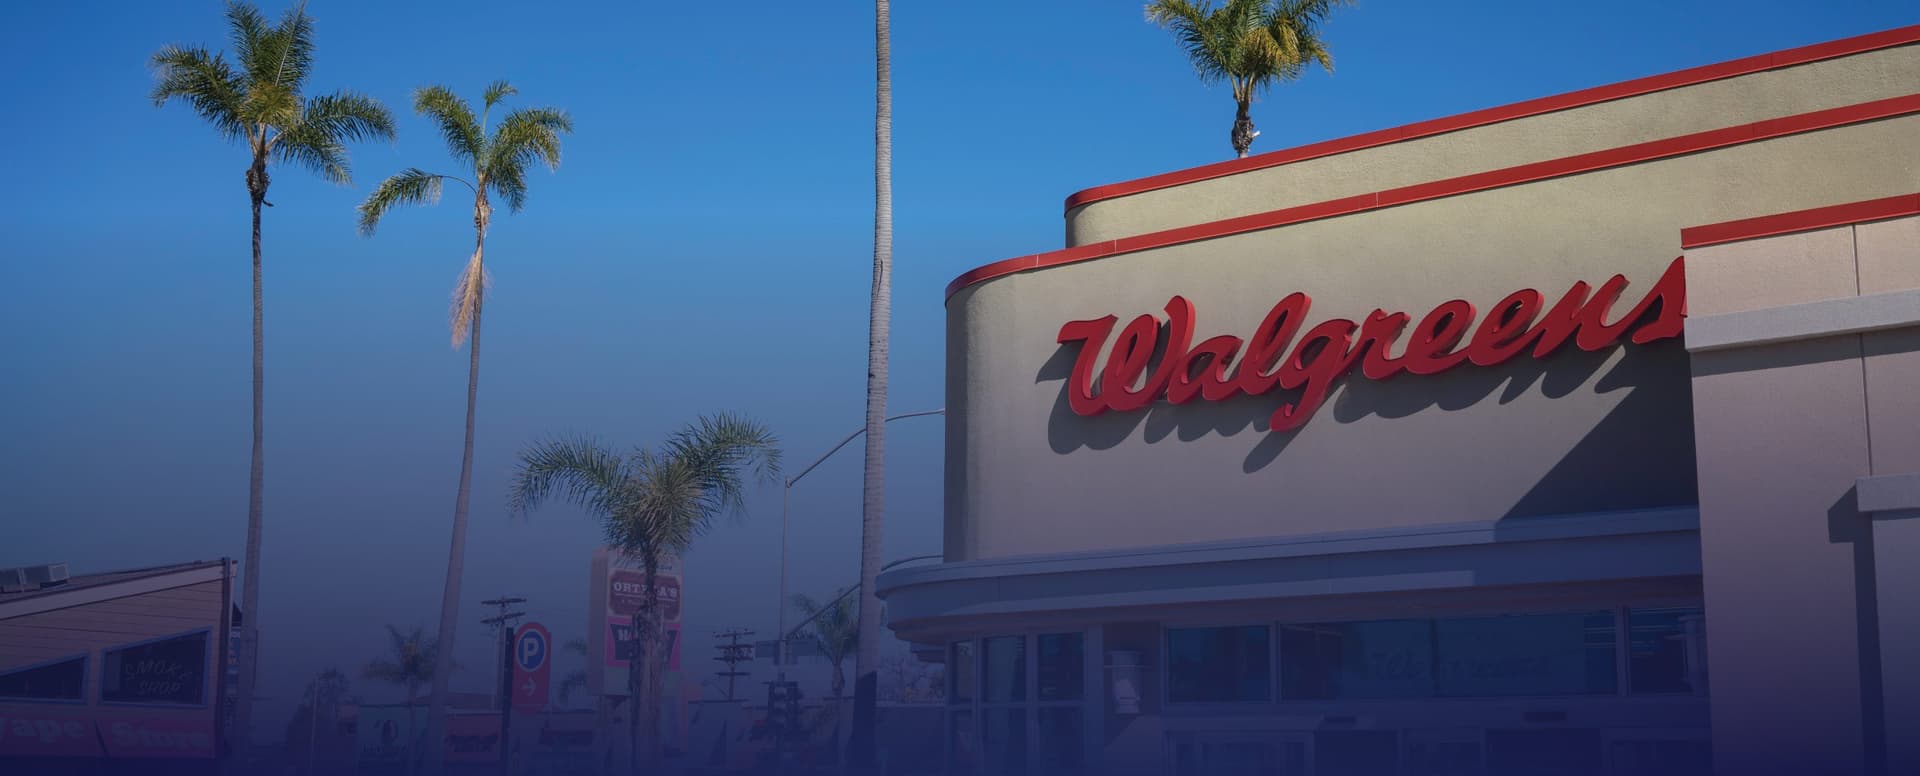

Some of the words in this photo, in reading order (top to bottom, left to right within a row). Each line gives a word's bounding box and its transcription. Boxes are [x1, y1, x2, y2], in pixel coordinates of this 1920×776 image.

[1057, 256, 1687, 432] Walgreens
[524, 638, 538, 664] P
[138, 681, 182, 697] SHOP
[111, 722, 209, 749] Store
